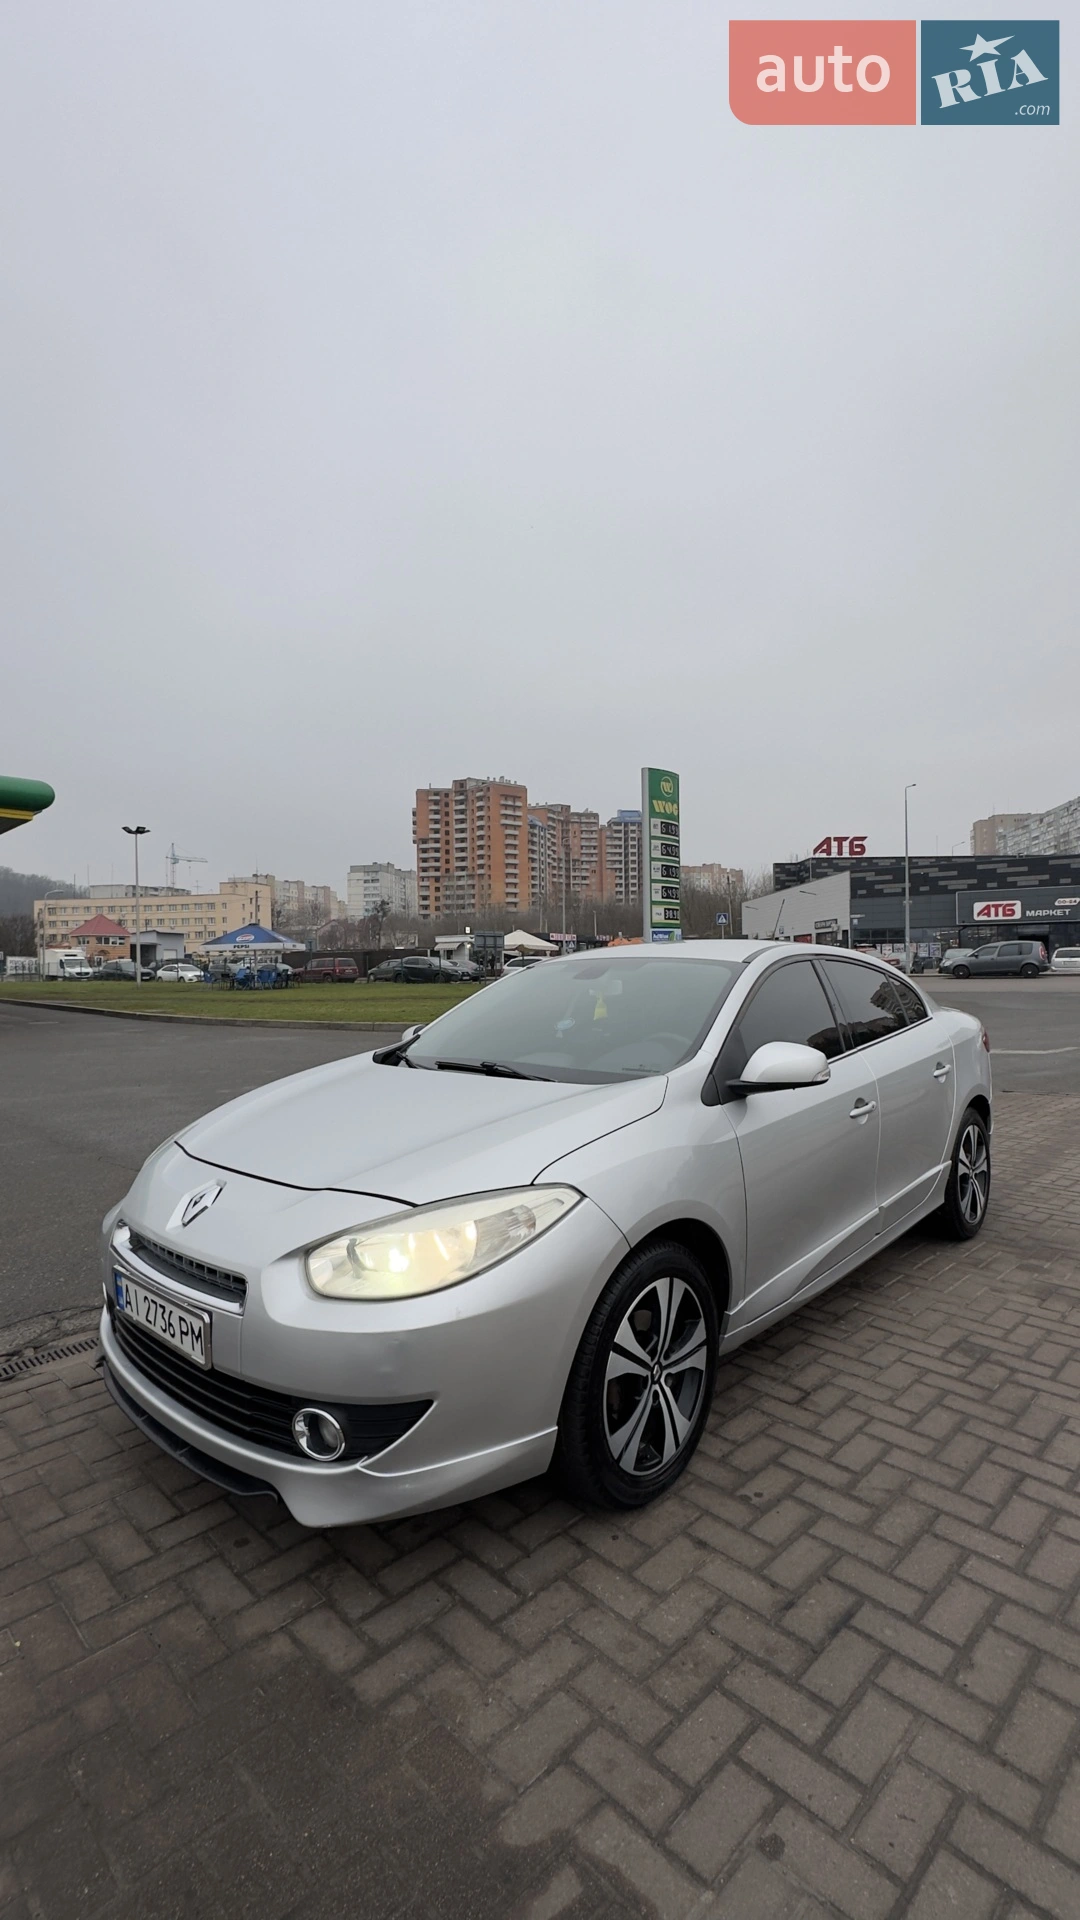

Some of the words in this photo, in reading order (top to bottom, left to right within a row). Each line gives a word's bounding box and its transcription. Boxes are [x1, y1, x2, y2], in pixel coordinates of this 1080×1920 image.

[813, 836, 868, 856] АТБ
[977, 903, 1017, 917] АТБ
[1026, 909, 1071, 917] МАРКЕТ
[143, 1296, 175, 1338] 2736
[179, 1315, 204, 1356] PM
